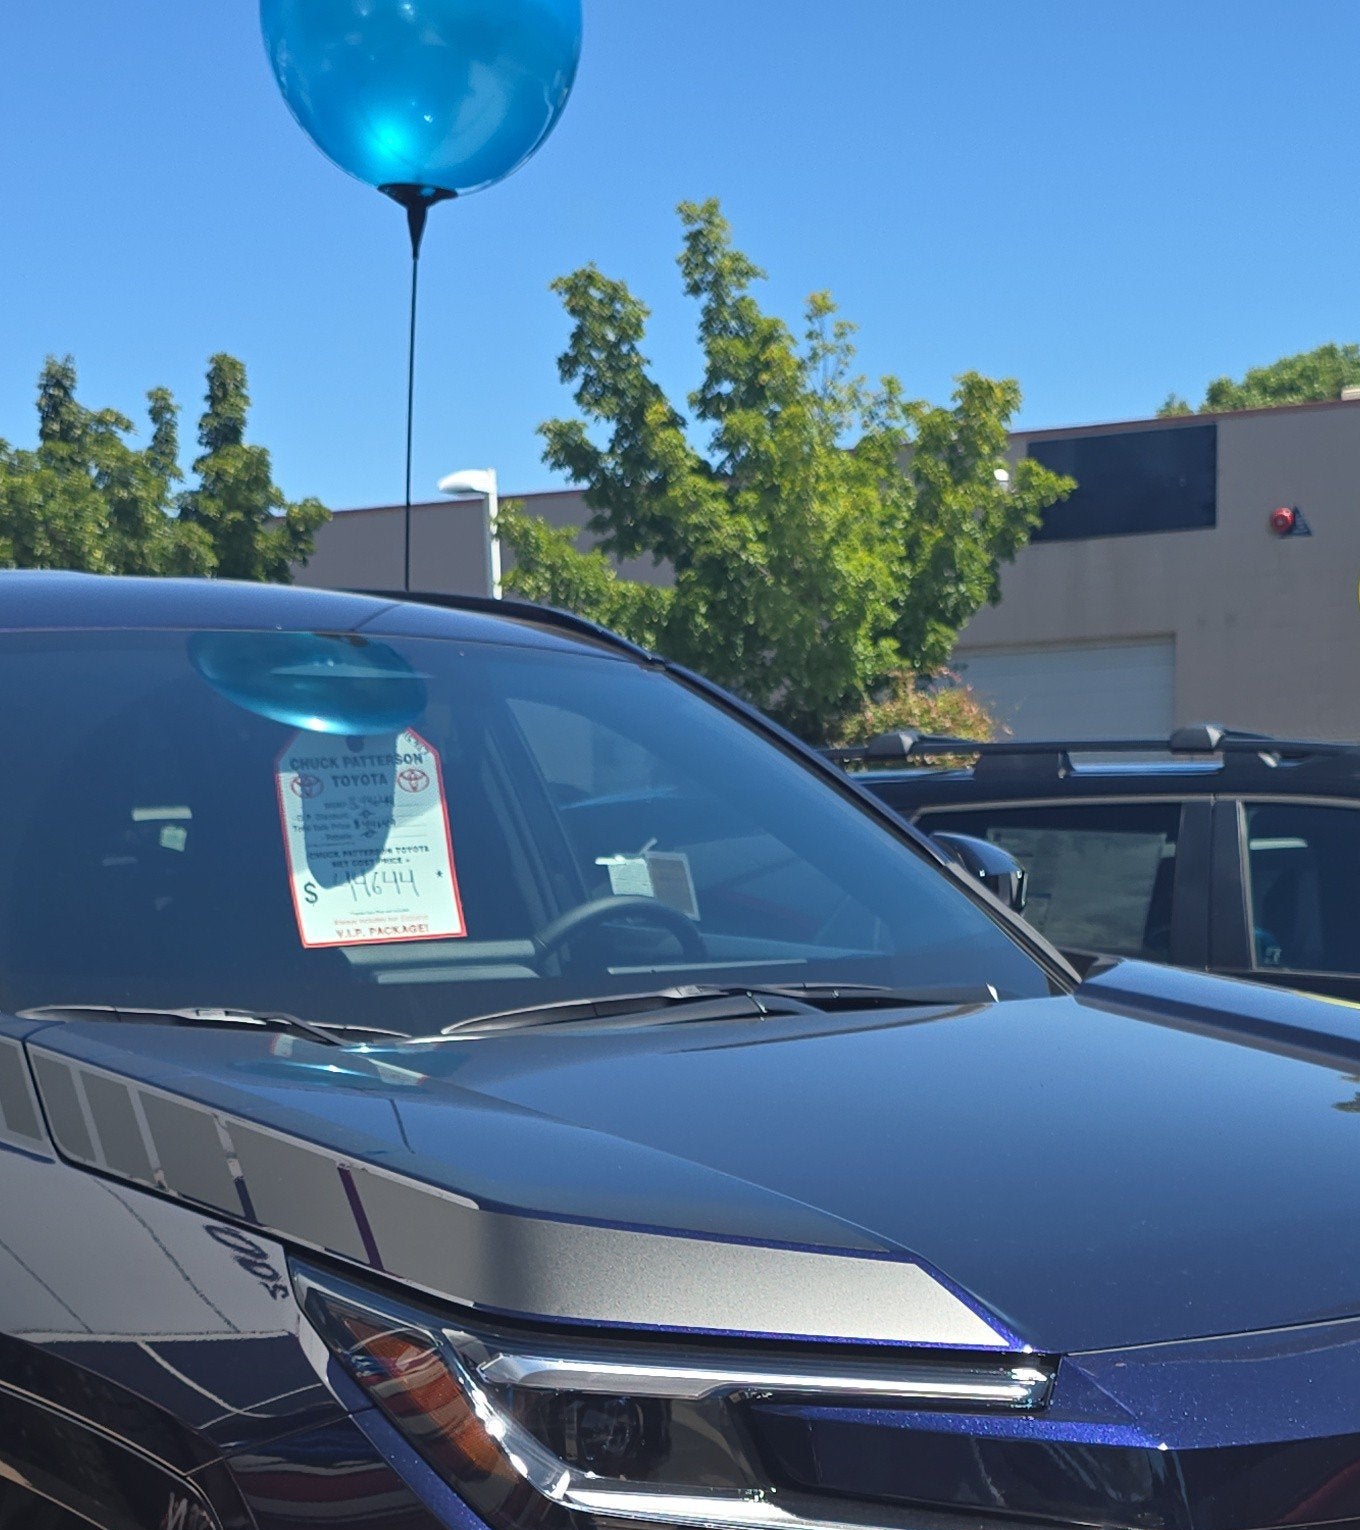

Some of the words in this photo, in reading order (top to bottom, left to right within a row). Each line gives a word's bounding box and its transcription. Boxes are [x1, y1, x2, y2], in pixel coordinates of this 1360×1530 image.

[290, 755, 339, 770] CHUCK
[344, 753, 423, 768] PATTERSON
[332, 775, 388, 788] TOYOTA
[395, 846, 429, 854] TOYOTA
[304, 882, 318, 905] $
